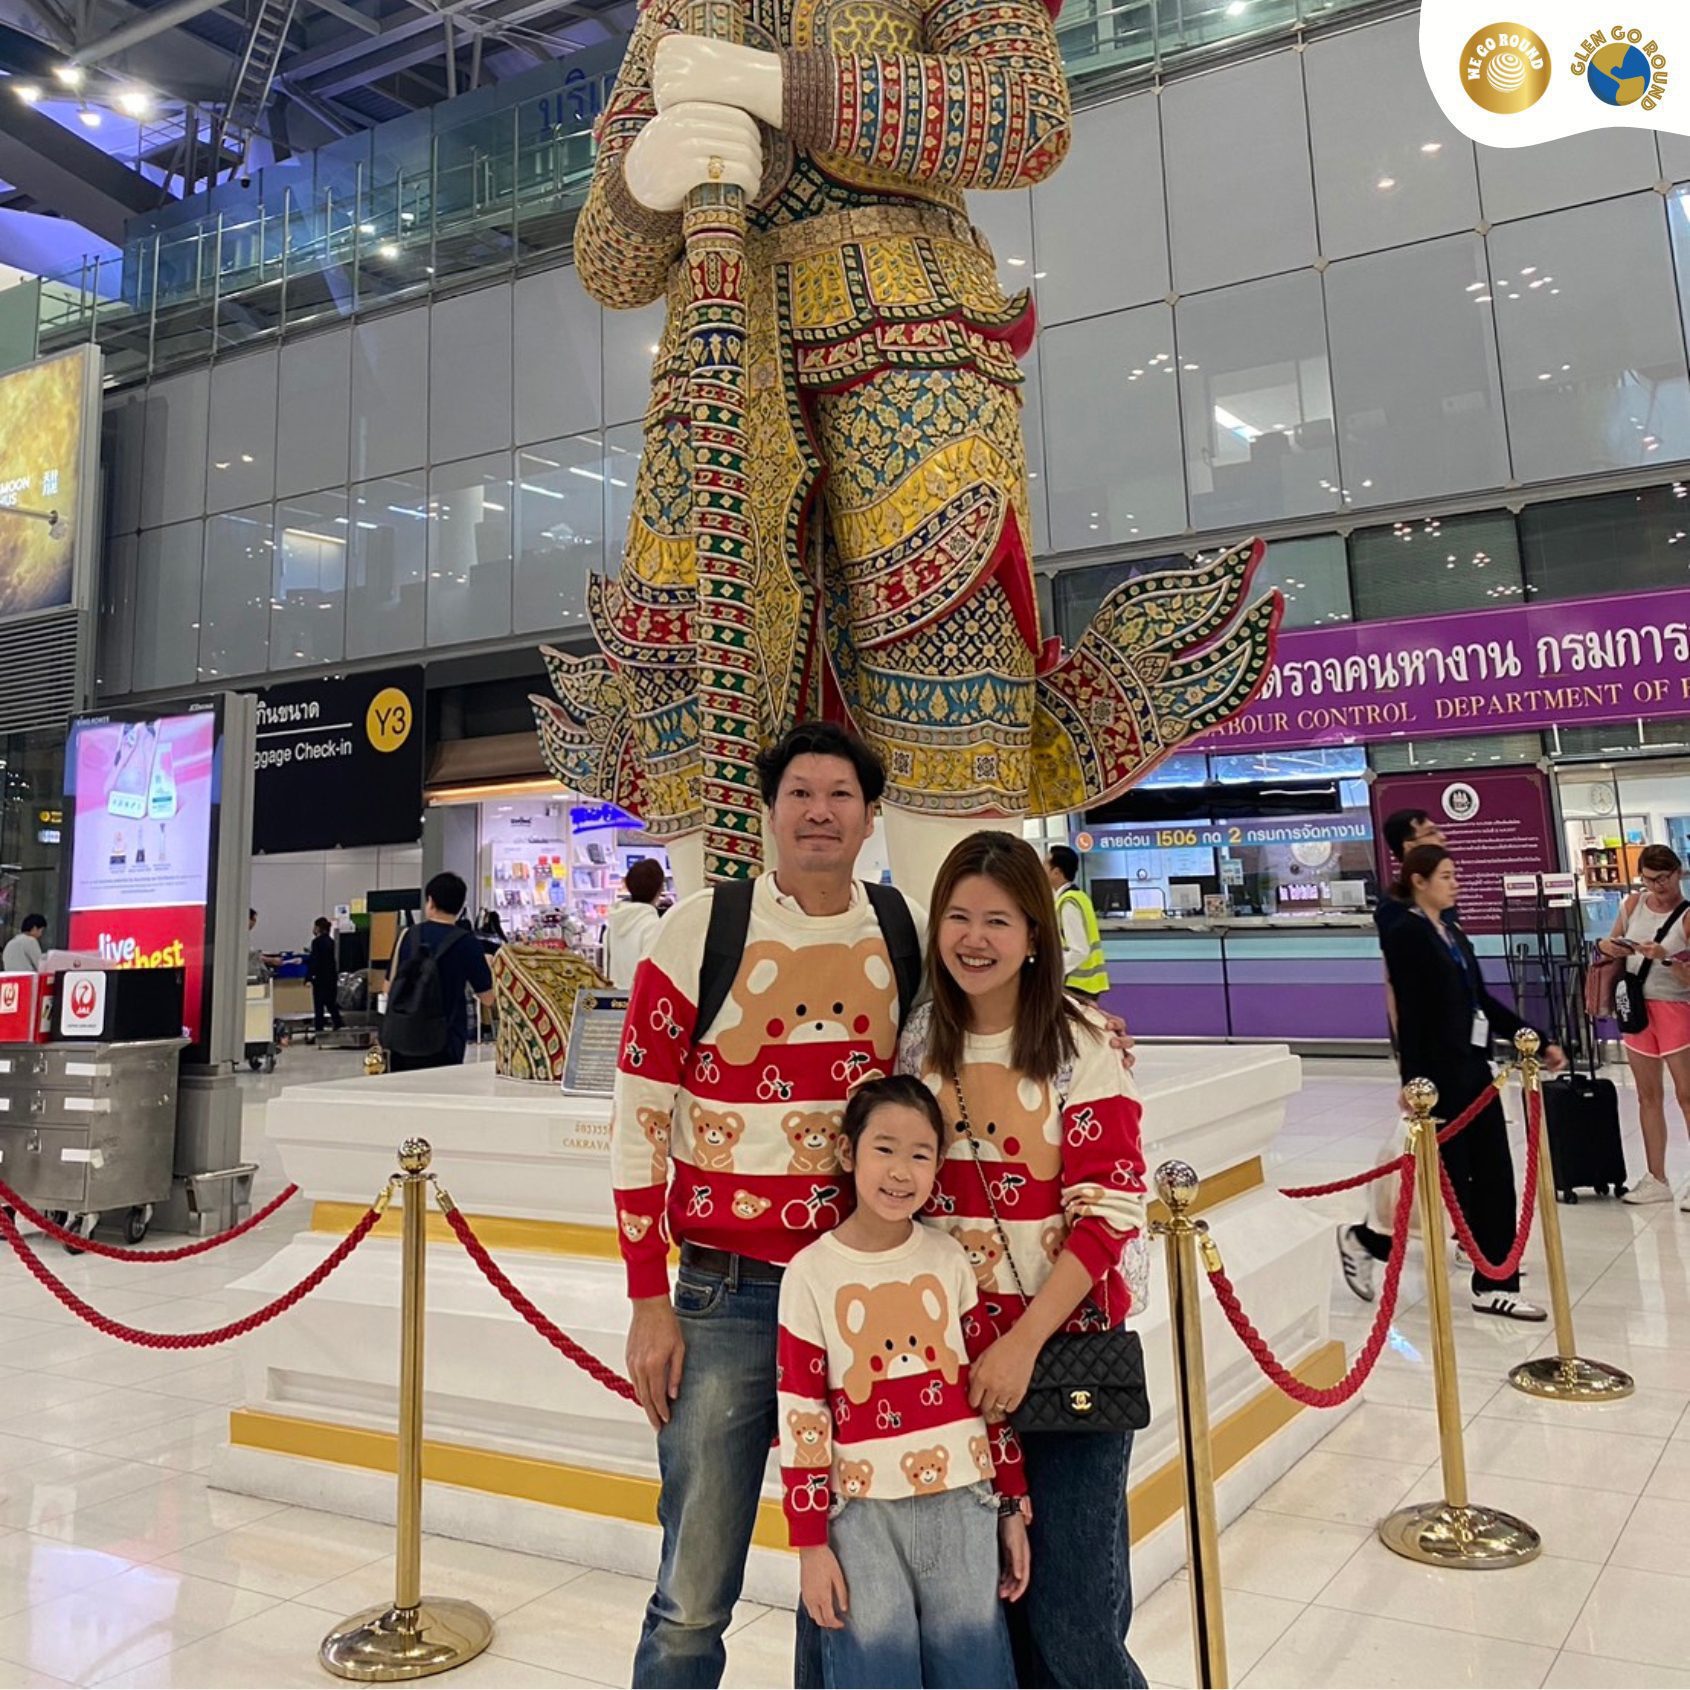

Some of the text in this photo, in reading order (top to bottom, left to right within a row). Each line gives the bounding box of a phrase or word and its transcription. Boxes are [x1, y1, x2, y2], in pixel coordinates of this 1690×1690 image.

[1255, 622, 1690, 699] ตรวจคนหางาน กรมการ
[375, 706, 406, 736] Y3
[1207, 711, 1289, 737] BOUR
[1297, 702, 1417, 730] CONTROL
[1435, 683, 1623, 719] DEPARTMENT
[1633, 679, 1671, 702] OF
[295, 738, 352, 761] Check-in
[1100, 823, 1366, 849] สายด่วน 1506 กด 2 กรมการจัดหางาน
[98, 933, 135, 962] live
